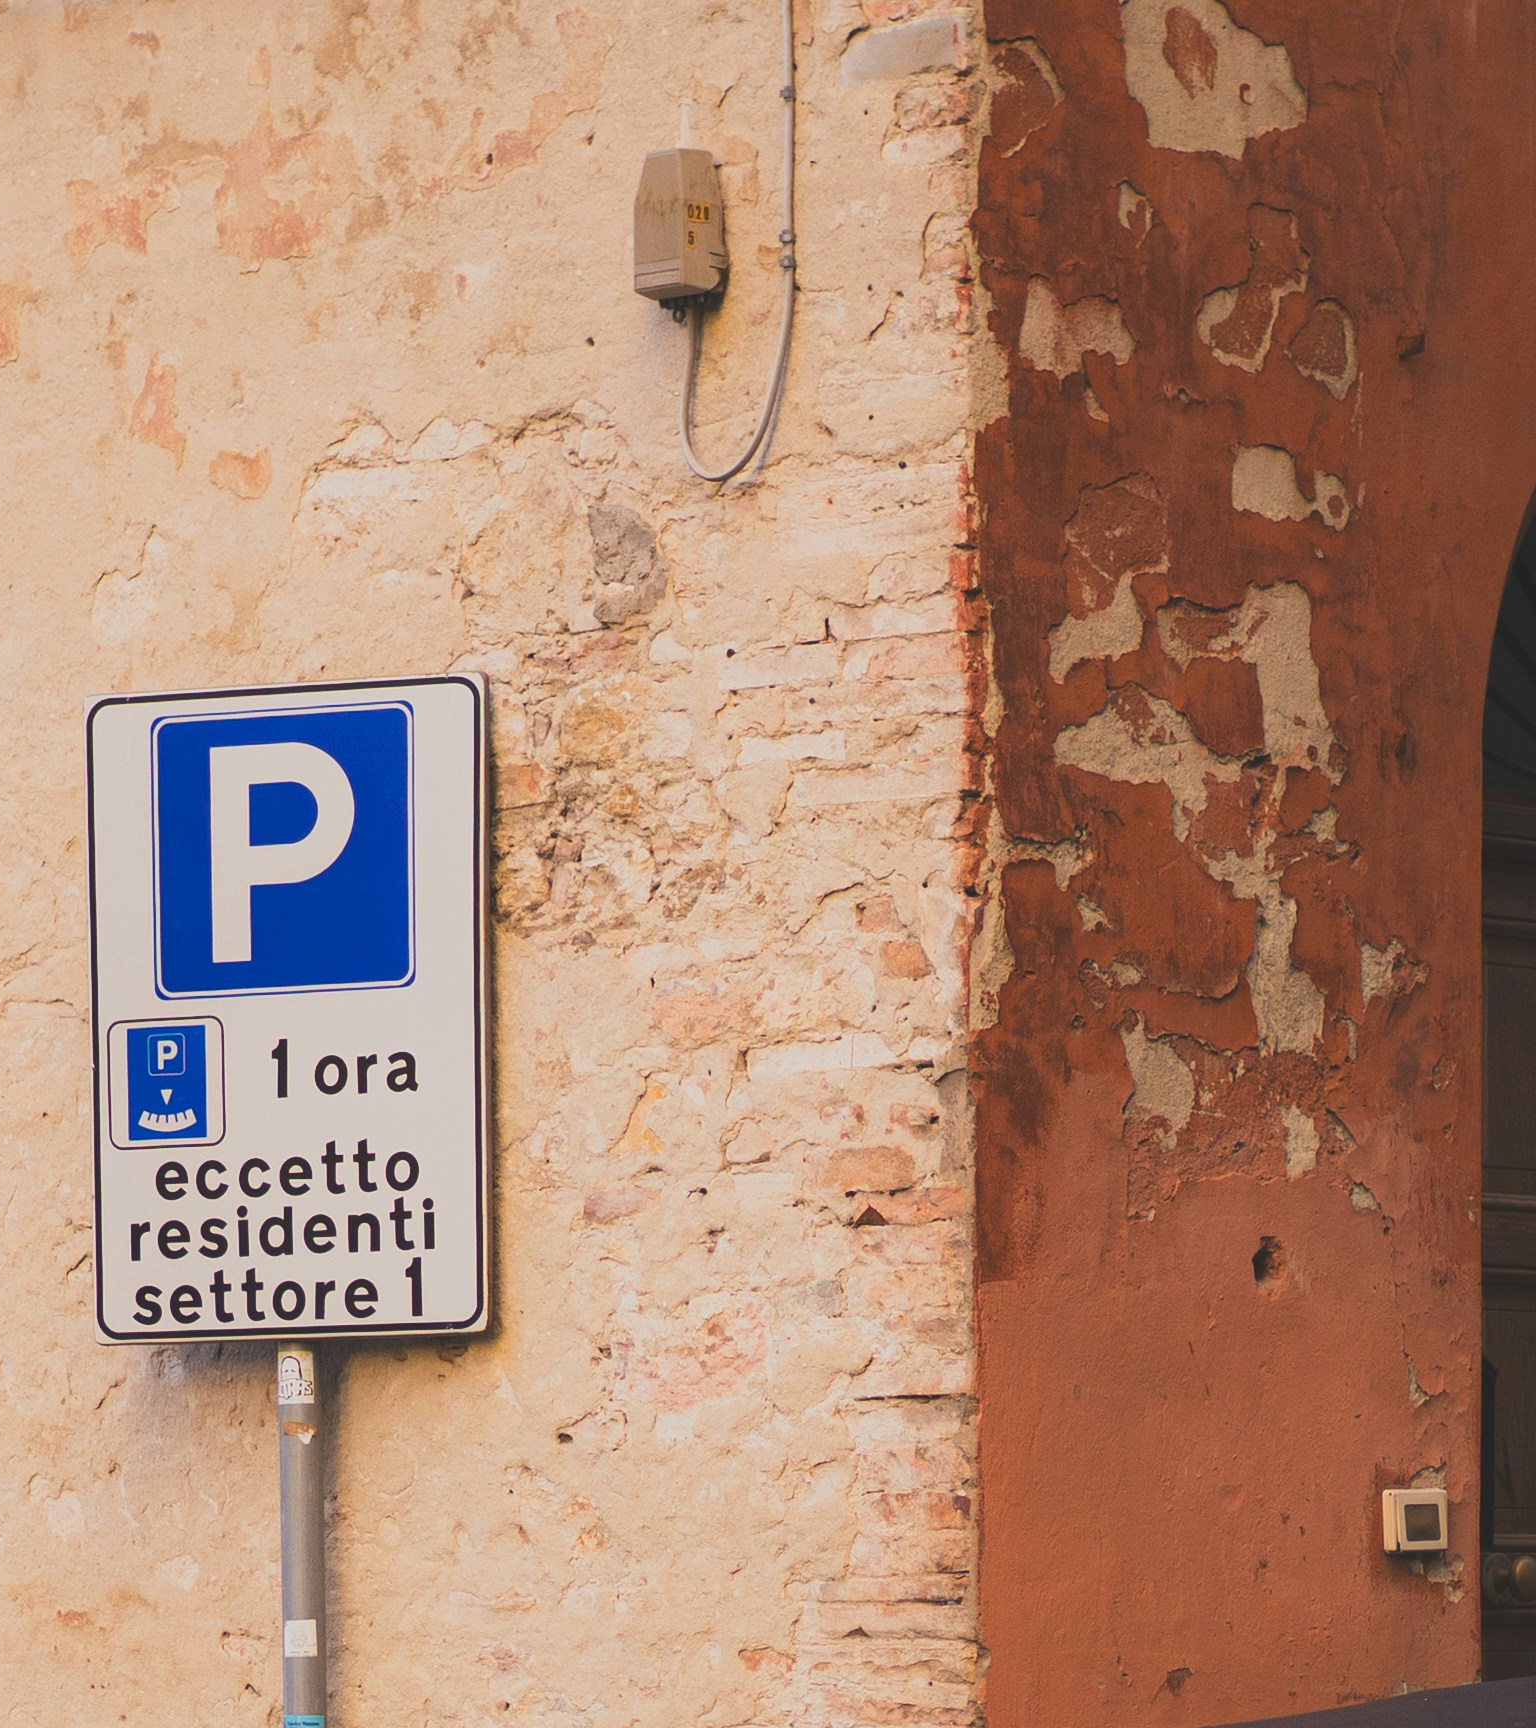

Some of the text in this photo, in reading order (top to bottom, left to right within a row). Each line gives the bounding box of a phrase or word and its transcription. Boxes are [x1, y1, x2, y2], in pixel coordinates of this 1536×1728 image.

[687, 230, 695, 246] 5
[210, 742, 355, 963] P
[157, 1040, 178, 1070] P
[271, 1038, 420, 1099] 1 ora
[155, 1139, 420, 1201] eccetto
[130, 1197, 436, 1262] residenti
[132, 1256, 424, 1326] settore 1
